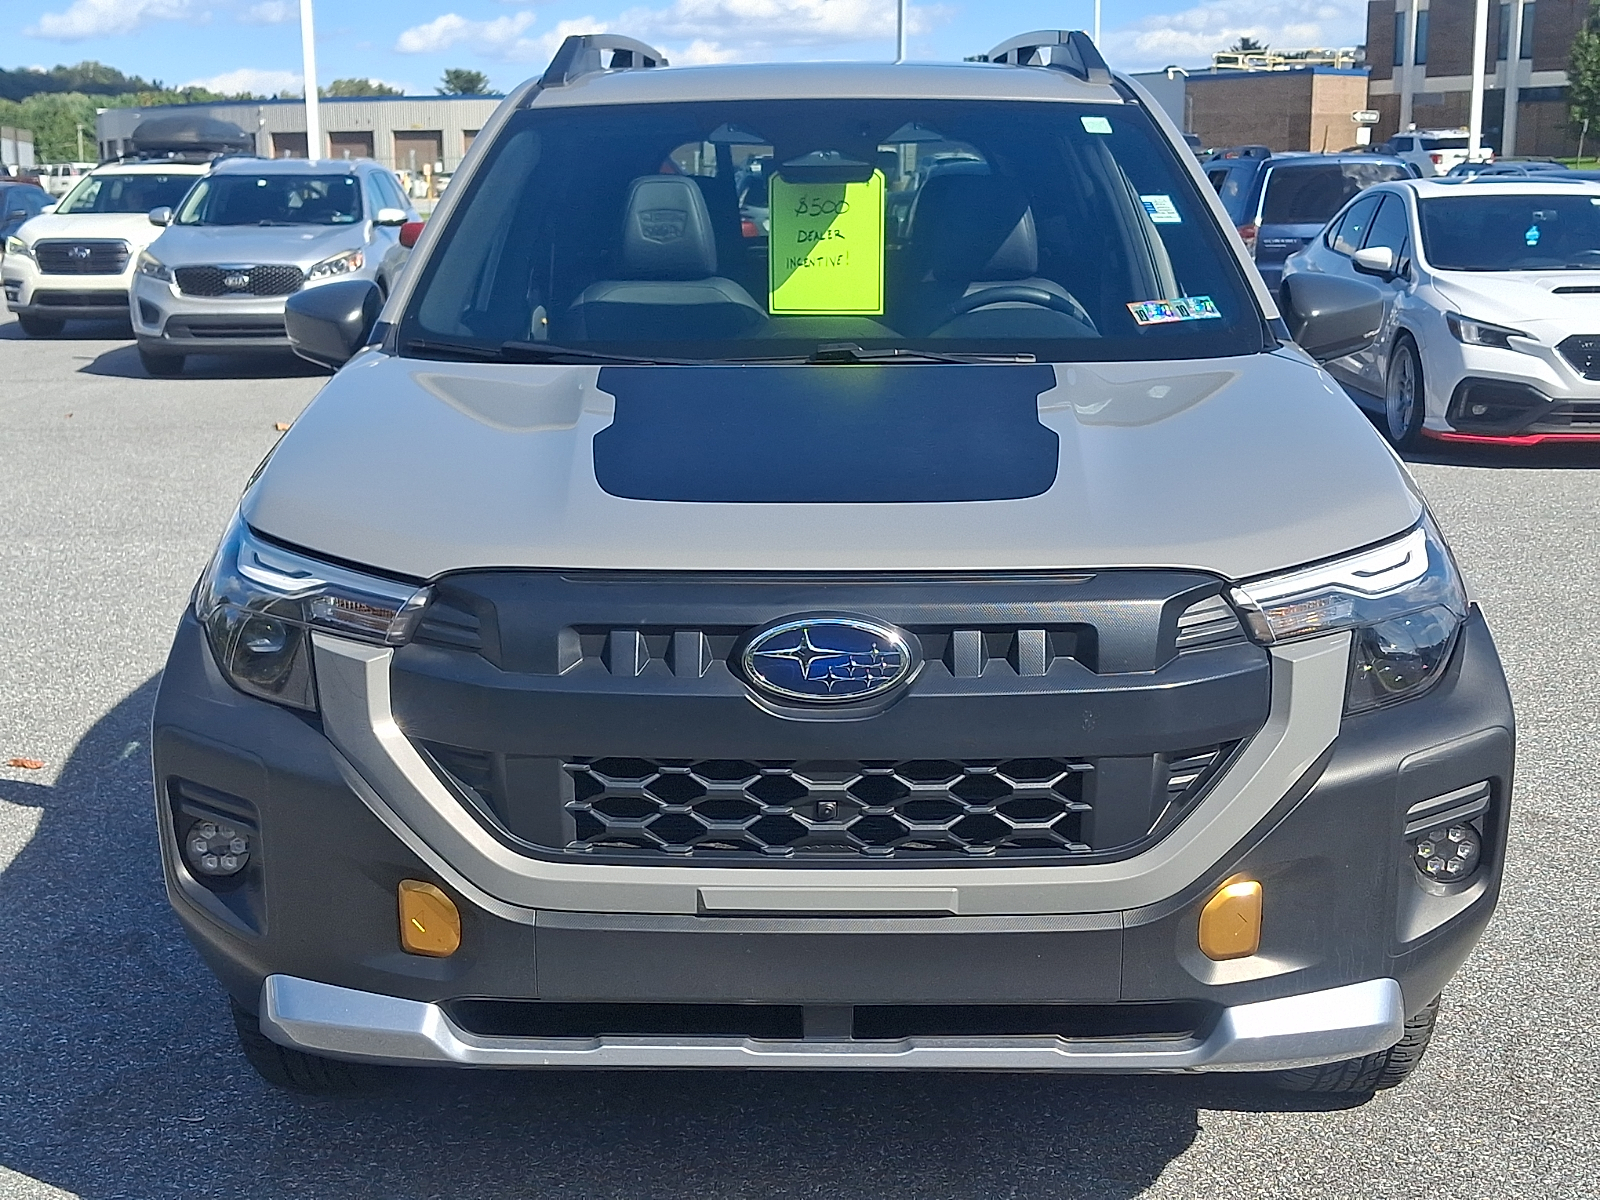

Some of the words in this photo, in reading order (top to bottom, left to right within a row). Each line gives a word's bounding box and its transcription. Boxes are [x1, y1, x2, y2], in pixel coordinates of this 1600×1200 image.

[795, 197, 850, 217] $500
[797, 229, 845, 243] DEALER
[786, 251, 849, 269] INCENTIVE!
